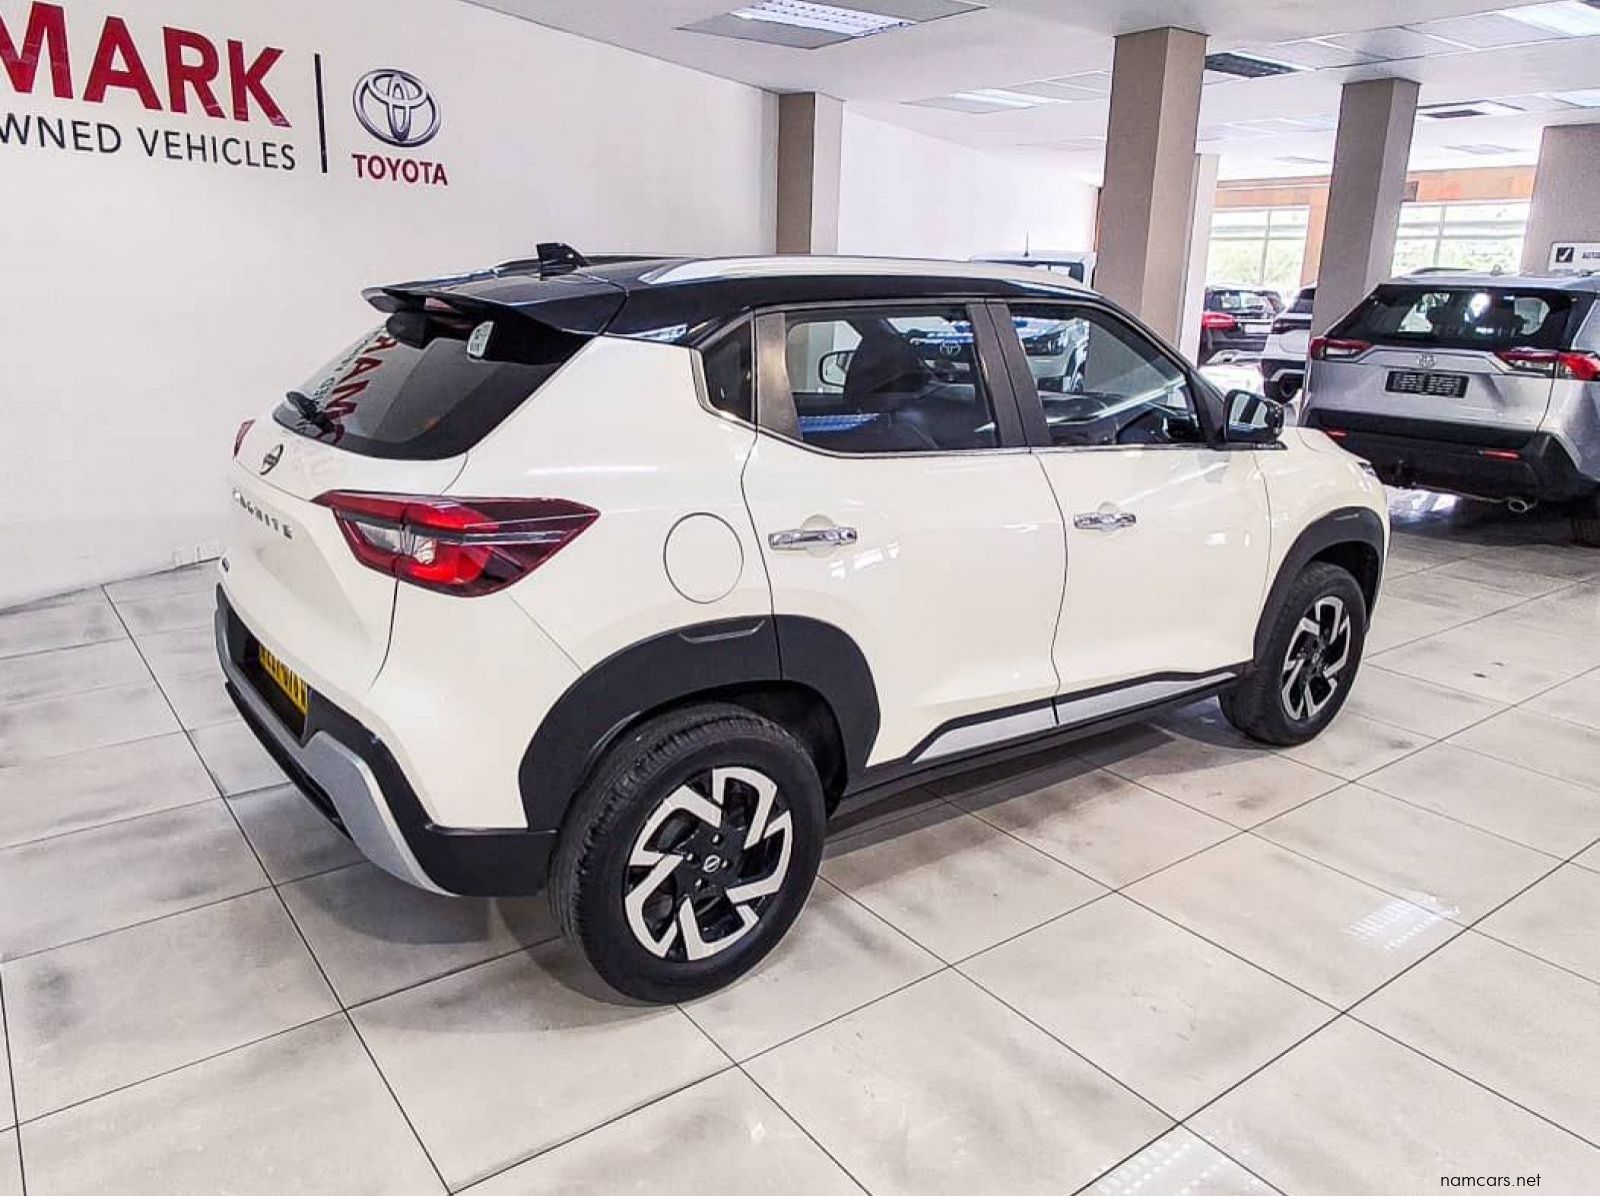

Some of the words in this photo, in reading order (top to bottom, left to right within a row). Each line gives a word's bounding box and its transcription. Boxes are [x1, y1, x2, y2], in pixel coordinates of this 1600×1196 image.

[0, 1, 292, 127] MARK
[137, 128, 296, 170] VEHICLES
[352, 153, 448, 186] TOYOTA
